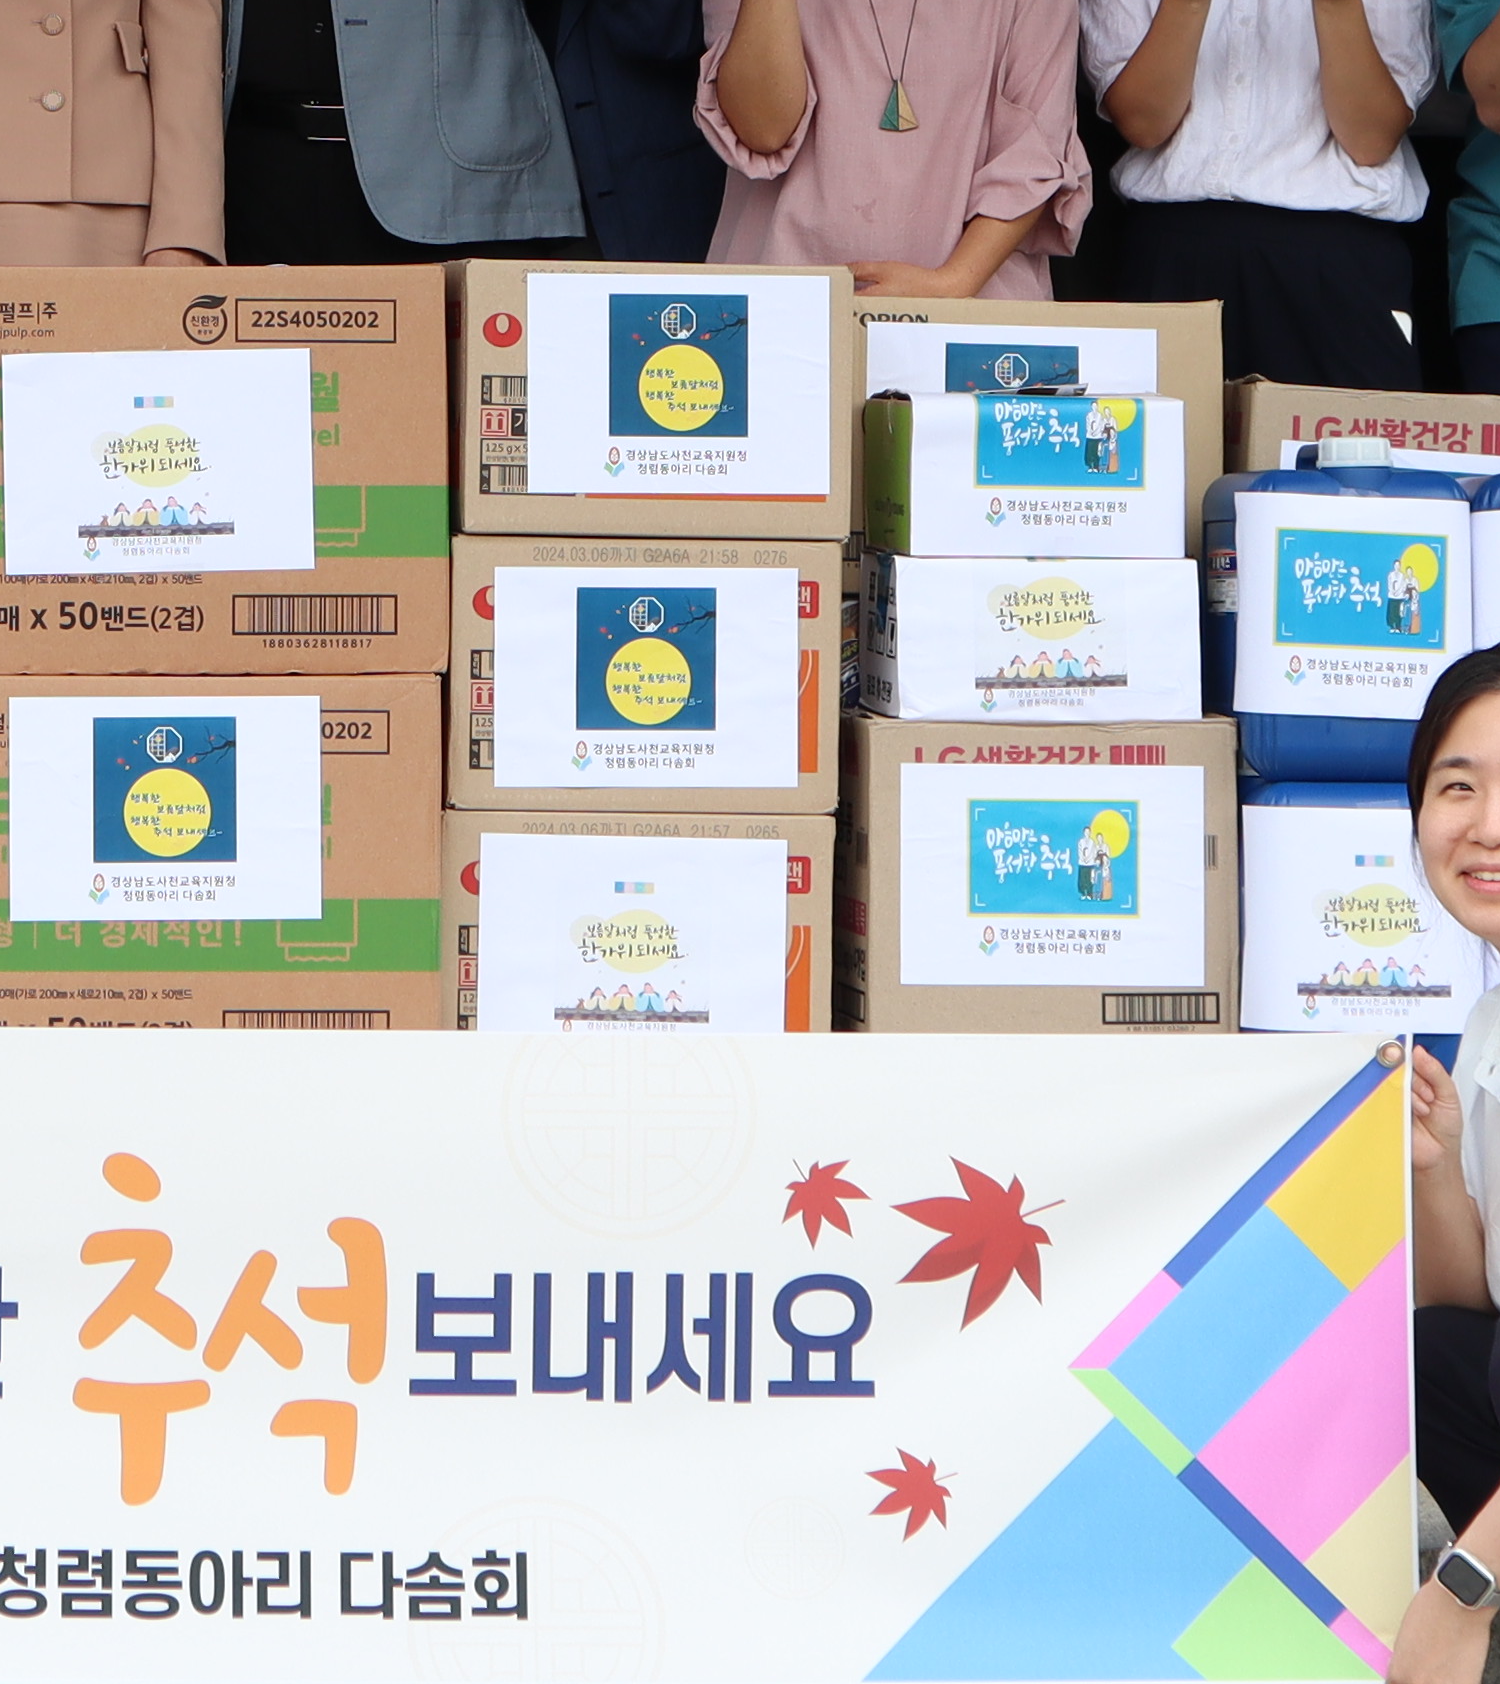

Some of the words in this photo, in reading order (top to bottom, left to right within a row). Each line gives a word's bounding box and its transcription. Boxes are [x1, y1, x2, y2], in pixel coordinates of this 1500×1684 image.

[190, 315, 219, 327] 친환경
[250, 310, 380, 329] 22S4050202
[700, 549, 739, 564] 21:58
[753, 550, 788, 565] 0276
[1350, 566, 1382, 613] 추석
[30, 608, 48, 630] x
[262, 638, 373, 649] 18803628118817
[1040, 834, 1073, 881] 추석
[71, 1150, 390, 1506] 추석
[406, 1268, 879, 1406] 보내세요
[339, 1548, 532, 1622] 다솜회
